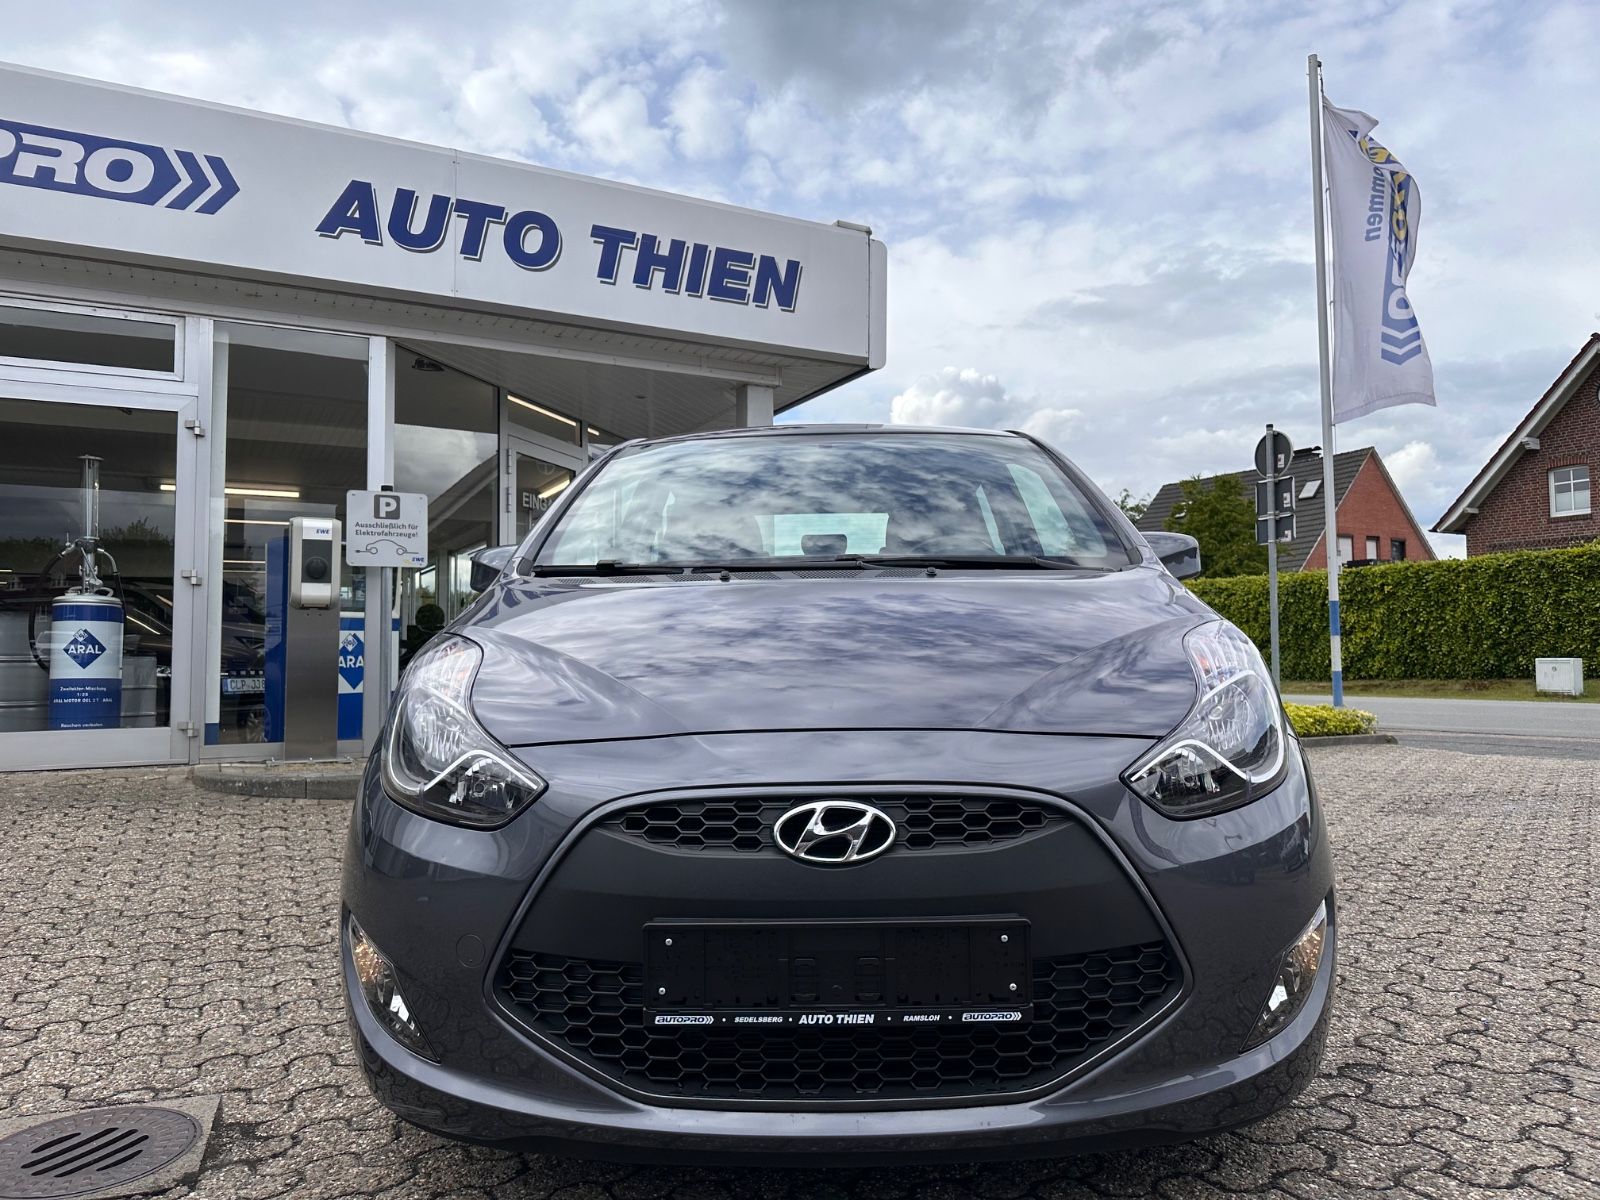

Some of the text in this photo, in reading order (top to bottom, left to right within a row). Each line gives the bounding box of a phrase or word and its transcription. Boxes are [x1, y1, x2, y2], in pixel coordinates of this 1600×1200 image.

[0, 128, 155, 194] RO
[315, 178, 803, 313] AUTO THIEN
[379, 497, 397, 517] P
[355, 522, 407, 530] Ausschließlich
[355, 530, 418, 539] Elektrofahrzeuge!
[68, 645, 101, 654] ARAL
[798, 1014, 831, 1025] AUTO
[836, 1014, 875, 1024] THIEN
[903, 1014, 941, 1022] RAMSLOH
